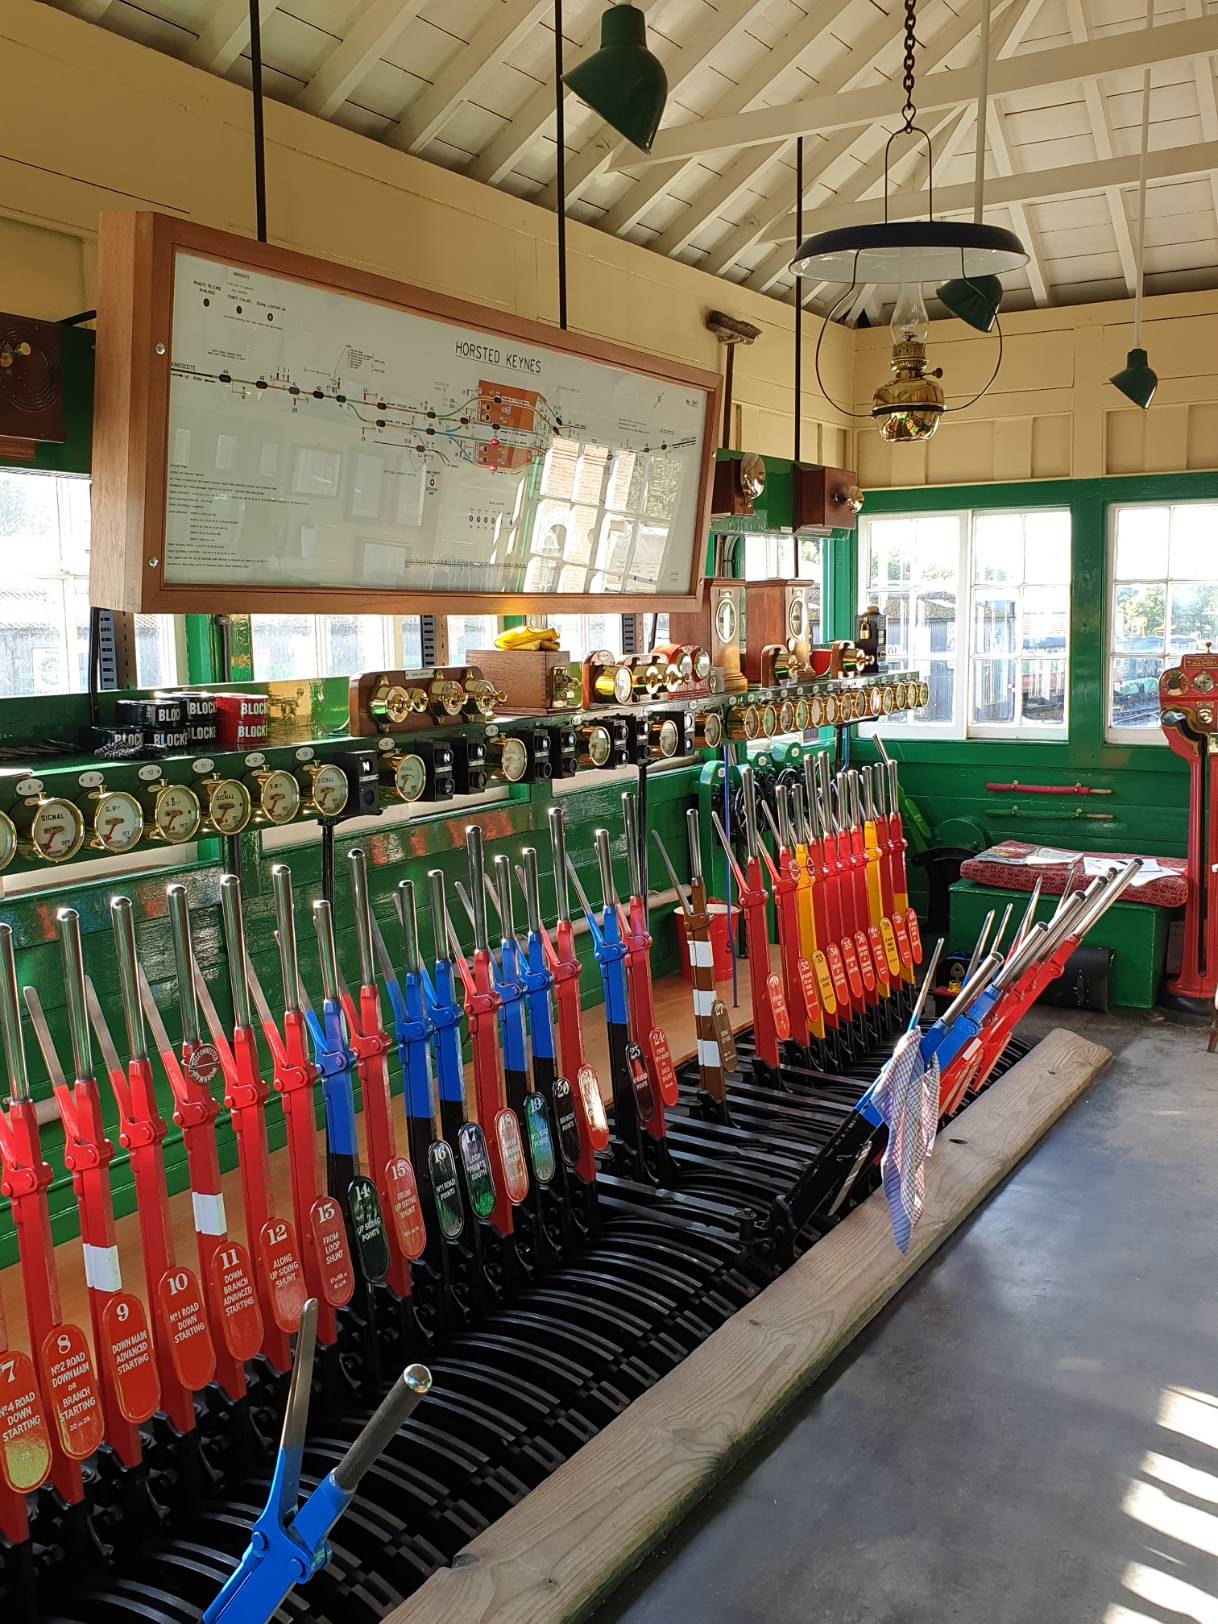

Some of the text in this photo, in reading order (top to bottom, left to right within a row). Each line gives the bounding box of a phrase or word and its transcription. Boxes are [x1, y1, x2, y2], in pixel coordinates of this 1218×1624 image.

[455, 340, 542, 374] HORSTED KEYNES
[443, 753, 450, 763] N
[477, 747, 483, 756] N
[362, 761, 370, 772] N
[41, 814, 65, 822] SIGNAL
[653, 1033, 665, 1046] 24
[556, 1080, 570, 1098] 20
[530, 1097, 542, 1112] 19
[463, 1126, 476, 1144] 17
[433, 1145, 446, 1163] 16
[470, 1153, 481, 1164] LOOP
[471, 1170, 488, 1181] SOUTH
[355, 1182, 371, 1202] 14
[397, 1188, 411, 1201] FROM
[440, 1187, 456, 1200] POINTS
[394, 1195, 417, 1212] UP SIDING
[400, 1206, 416, 1219] SHUNT
[267, 1224, 288, 1246] 12
[357, 1216, 381, 1237] UP SIDING
[361, 1227, 380, 1243] POINTS
[322, 1231, 339, 1246] FROM
[325, 1241, 340, 1254] LOOP
[219, 1248, 240, 1270] 11
[273, 1253, 293, 1269] ALONG
[325, 1250, 344, 1265] SHUNT
[224, 1269, 243, 1284] DOWN
[269, 1261, 299, 1281] UP SIDING
[275, 1272, 297, 1288] SHUNT
[167, 1273, 189, 1296] 10
[223, 1277, 249, 1295] BRANCH
[223, 1286, 253, 1306] ADVANCED
[116, 1303, 129, 1322] 9
[181, 1302, 199, 1316] ROAD
[225, 1296, 255, 1317] STARTING
[178, 1314, 198, 1330] DOWN
[112, 1330, 147, 1354] DOWN MAIN
[174, 1322, 206, 1344] STARTING
[57, 1334, 71, 1354] 8
[66, 1352, 86, 1368] ROAD
[116, 1342, 148, 1365] ADVANCED
[0, 1360, 16, 1383] 7
[117, 1353, 149, 1375] STARTING
[52, 1362, 90, 1388] DOWN MAIN
[15, 1391, 36, 1408] ROAD
[63, 1386, 90, 1408] BRANCH
[7, 1406, 32, 1426] DOWN
[59, 1397, 96, 1422] STARTING
[2, 1415, 41, 1442] STARTING
